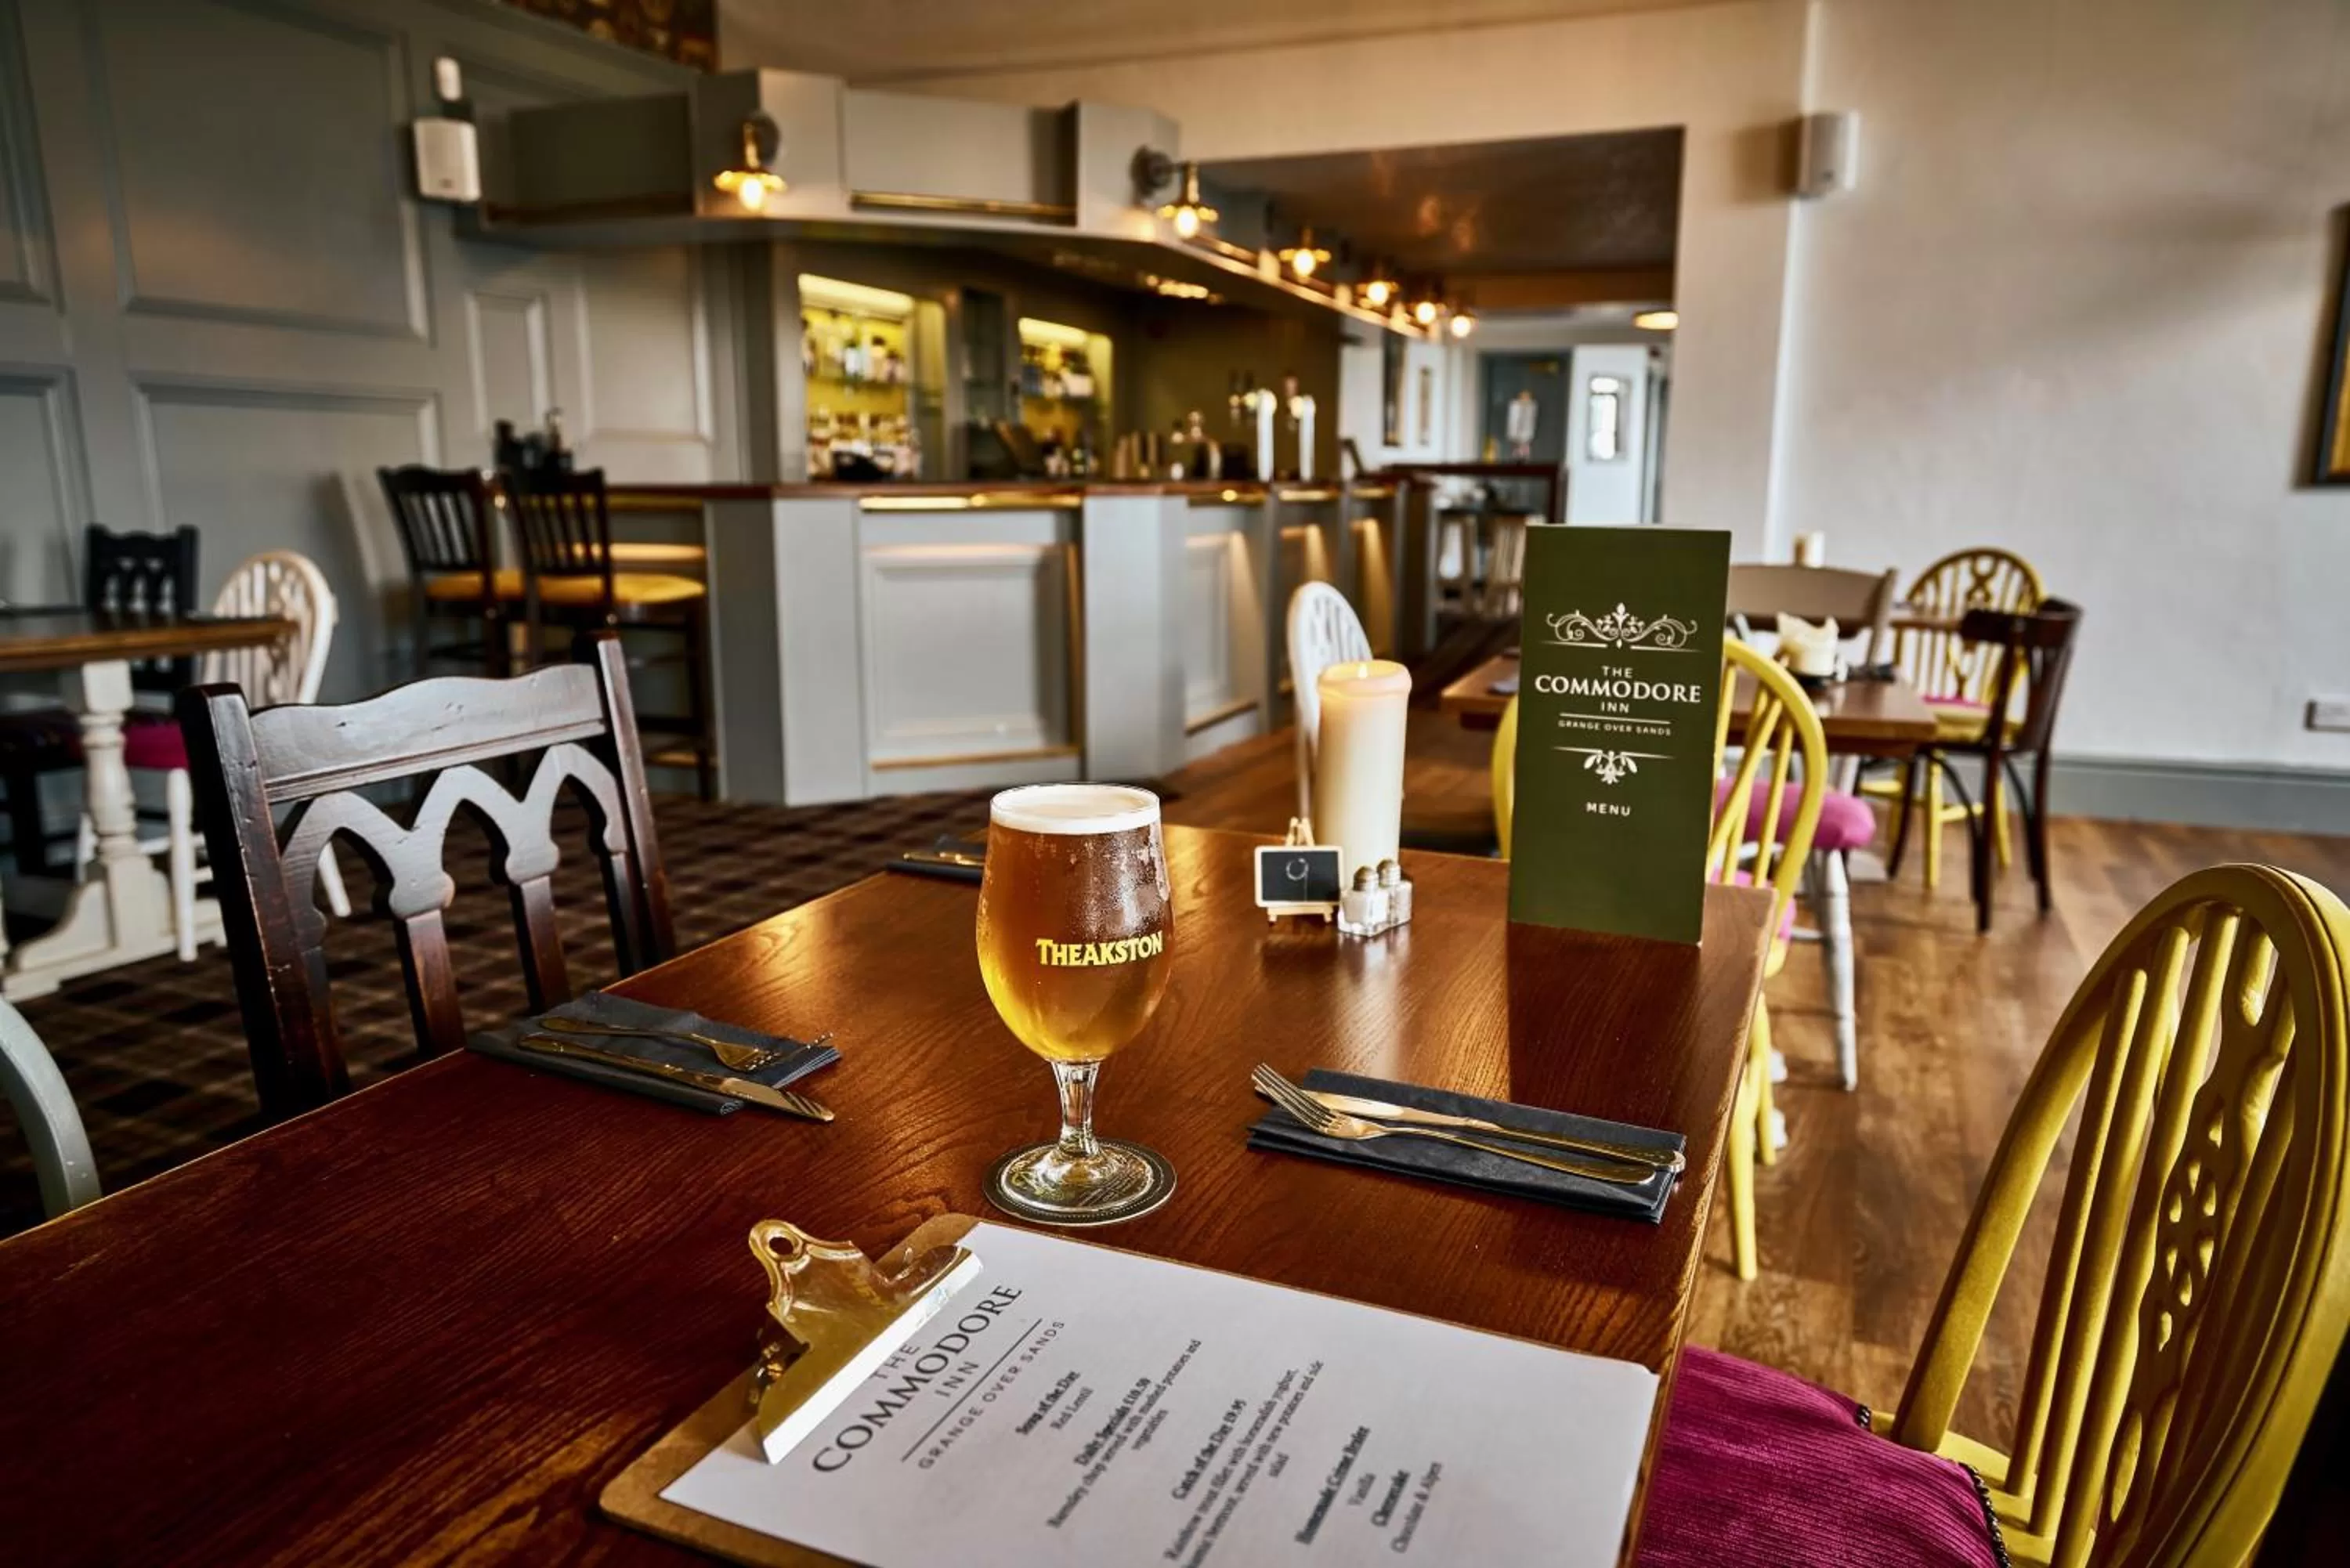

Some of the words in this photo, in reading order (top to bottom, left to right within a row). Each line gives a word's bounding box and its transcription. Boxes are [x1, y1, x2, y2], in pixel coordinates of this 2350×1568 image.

[1535, 674, 1701, 703] COMMODORE
[1602, 666, 1633, 678] THE
[1601, 703, 1630, 714] INN
[1558, 720, 1600, 731] GRANGE
[1603, 723, 1632, 734] OVER
[1636, 726, 1672, 736] SANDS
[1586, 802, 1631, 816] MENU
[1036, 931, 1163, 966] THEAKSTON
[812, 1285, 1023, 1473] COMMODORE
[871, 1344, 921, 1380] THE
[935, 1361, 980, 1397] INN
[1161, 1353, 1191, 1387] potatoes
[917, 1406, 985, 1470] GRANGE
[981, 1366, 1022, 1404] OVER
[1019, 1321, 1065, 1364] SANDS
[1278, 1391, 1305, 1426] potatoes
[1171, 1469, 1202, 1500] Catch
